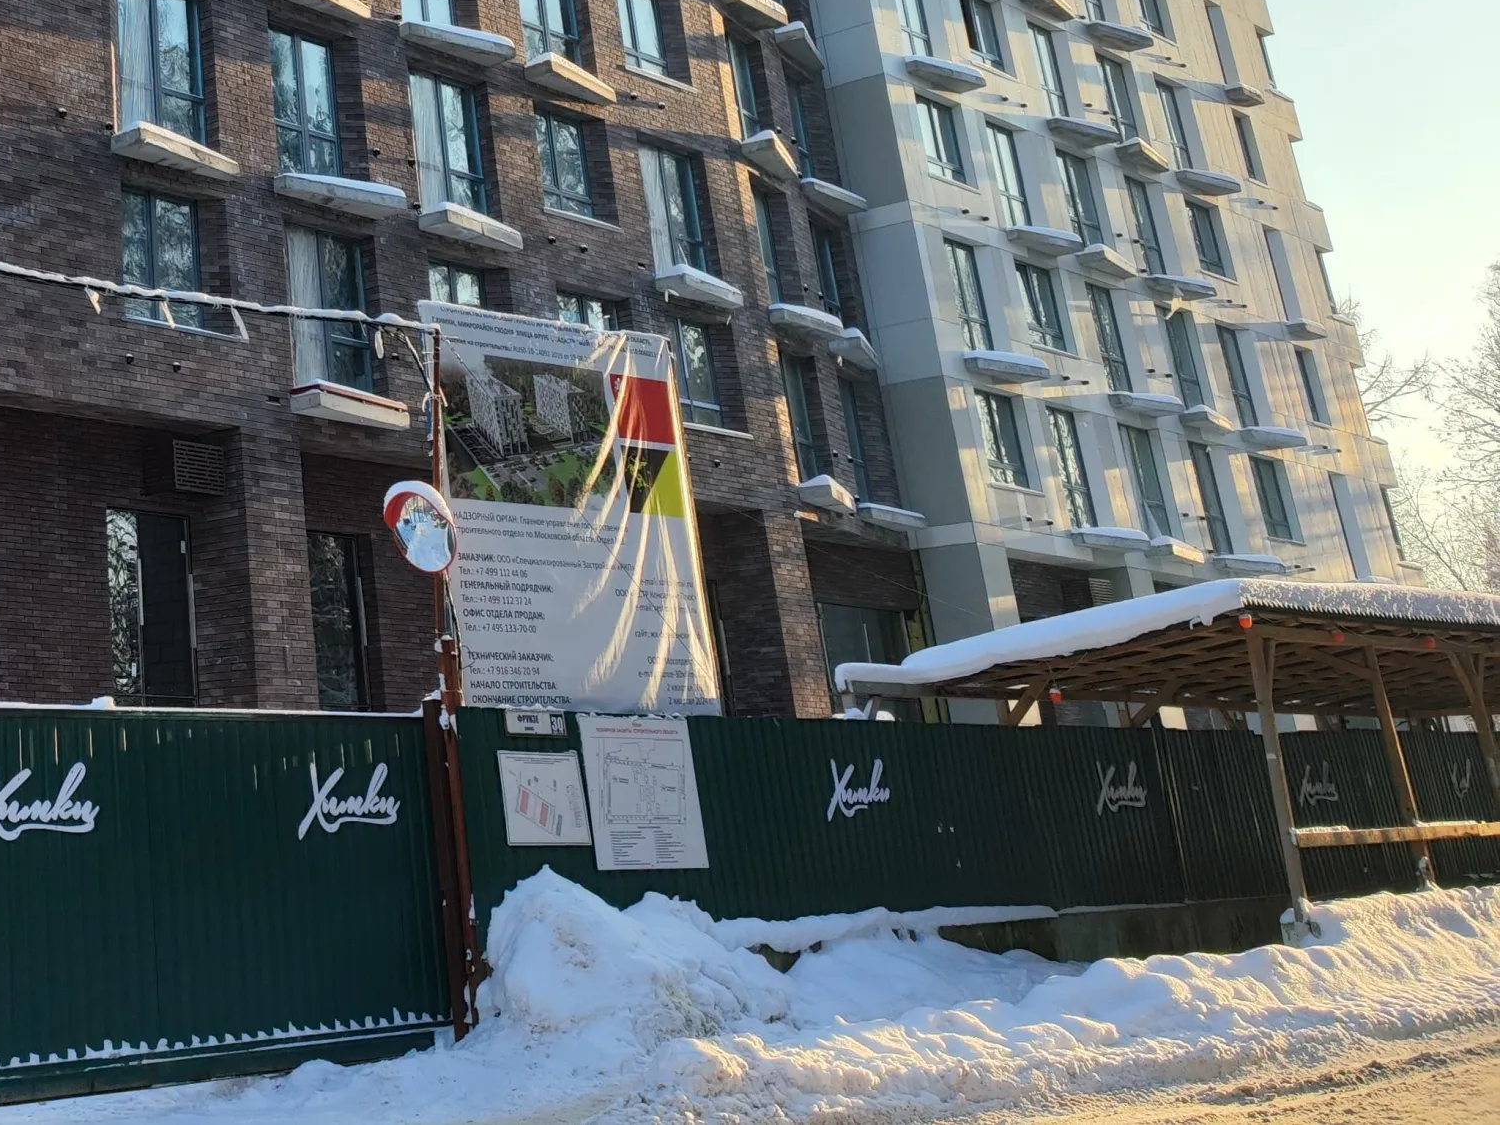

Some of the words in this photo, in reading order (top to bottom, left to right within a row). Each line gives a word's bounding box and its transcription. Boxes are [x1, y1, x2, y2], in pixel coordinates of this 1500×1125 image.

[453, 511, 495, 522] НАДЗОРНЫЙ
[496, 514, 518, 523] ОРГАН:
[520, 516, 545, 526] Главное
[503, 529, 525, 538] отдела
[534, 530, 571, 541] Московской
[457, 552, 496, 562] ЗАКАЗЧИК:
[497, 556, 511, 564] ООО
[459, 566, 474, 575] Тел.:
[476, 567, 483, 575] +7
[485, 568, 498, 576] 499
[500, 569, 510, 577] 112
[460, 580, 510, 592] ГЕНЕРАЛЬНЫЙ
[512, 584, 553, 594] ПОДРЯДЧИК:
[461, 594, 478, 604] Тел.:
[479, 595, 487, 603] +7
[487, 596, 500, 604] 499
[502, 596, 514, 605] 112
[515, 597, 523, 605] 37
[524, 597, 532, 606] 24
[463, 608, 485, 618] ОФИС
[486, 610, 513, 619] ОТДЕЛА
[514, 611, 545, 621] ПРОДАЖ:
[465, 622, 481, 632] Тел.:
[482, 624, 491, 632] +7
[492, 624, 504, 633] 495
[505, 624, 537, 634] 133-70-00
[467, 651, 516, 662] ТЕХНИЧЕСКИЙ
[518, 652, 554, 662] ЗАКАЗЧИК:
[469, 666, 486, 675] Тел.:
[487, 666, 495, 675] +7
[496, 667, 509, 675] 916
[509, 667, 522, 675] 346
[523, 667, 531, 675] 20
[531, 667, 540, 675] 94
[470, 680, 501, 689] НАЧАЛО
[502, 681, 558, 690] СТРОИТЕЛЬСТВА:
[472, 694, 516, 704] ОКОНЧАНИЕ
[517, 695, 572, 705] СТРОИТЕЛЬСТВА:
[551, 716, 563, 732] 30
[827, 758, 890, 822] Химки
[298, 762, 400, 841] Химки
